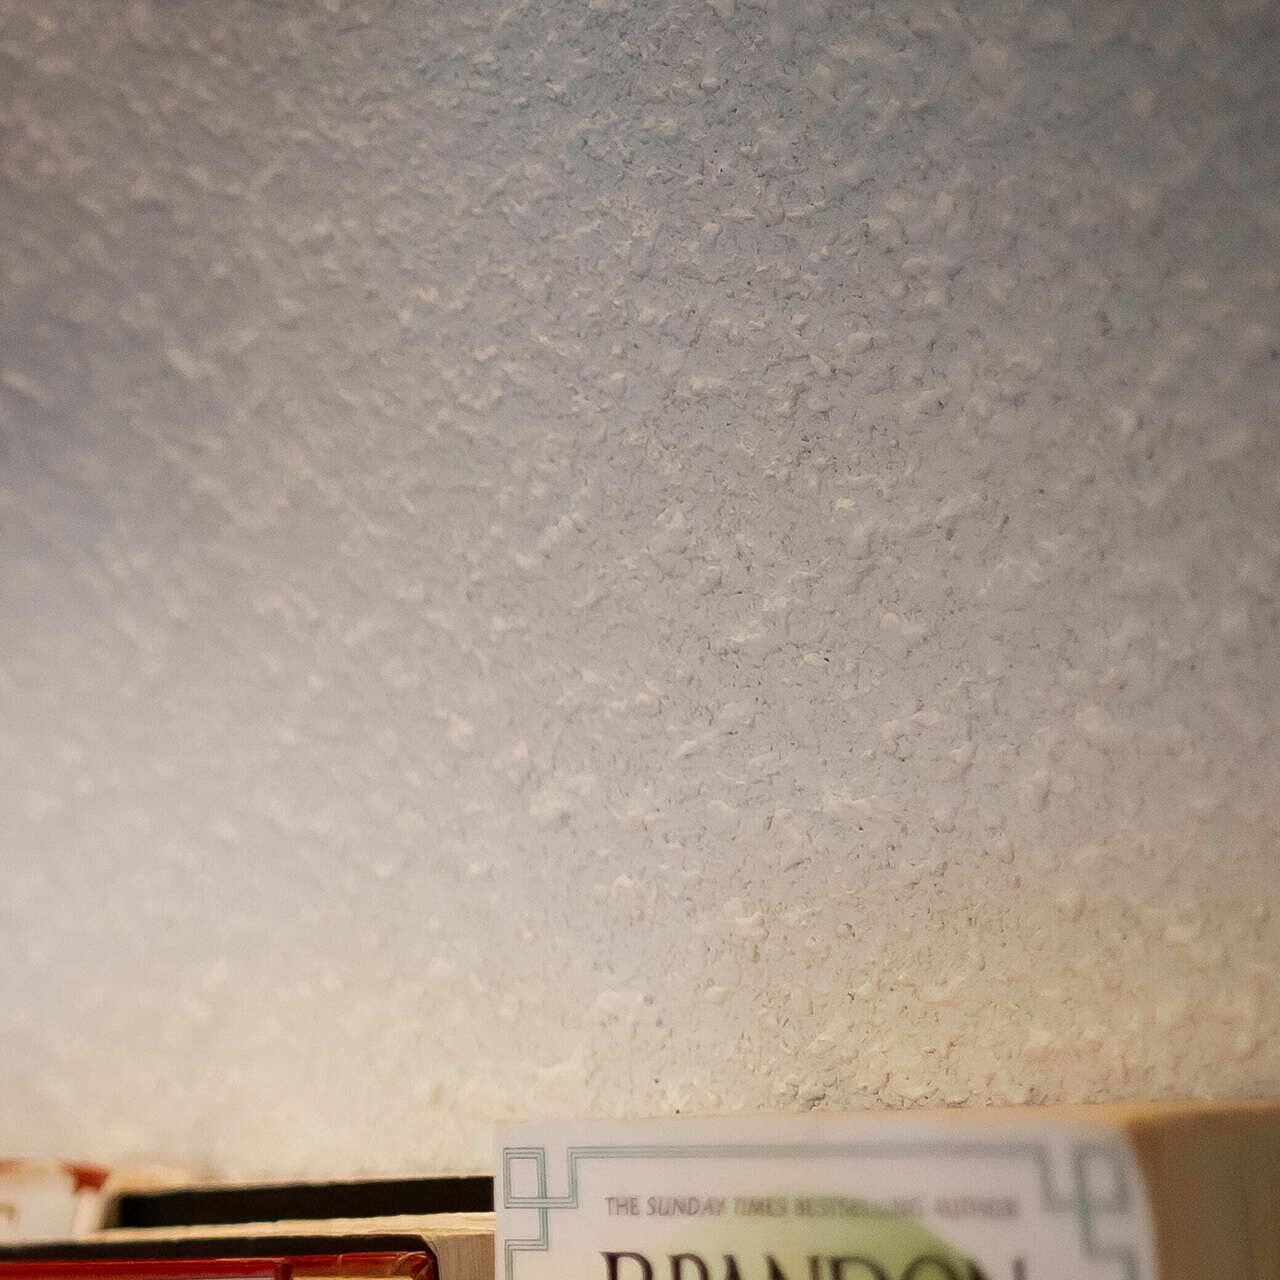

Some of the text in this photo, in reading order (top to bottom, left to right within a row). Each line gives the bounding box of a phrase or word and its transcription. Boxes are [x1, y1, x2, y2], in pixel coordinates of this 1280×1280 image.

[604, 1195, 641, 1218] THE
[645, 1195, 726, 1219] SUNDAY
[733, 1195, 788, 1219] TIMES
